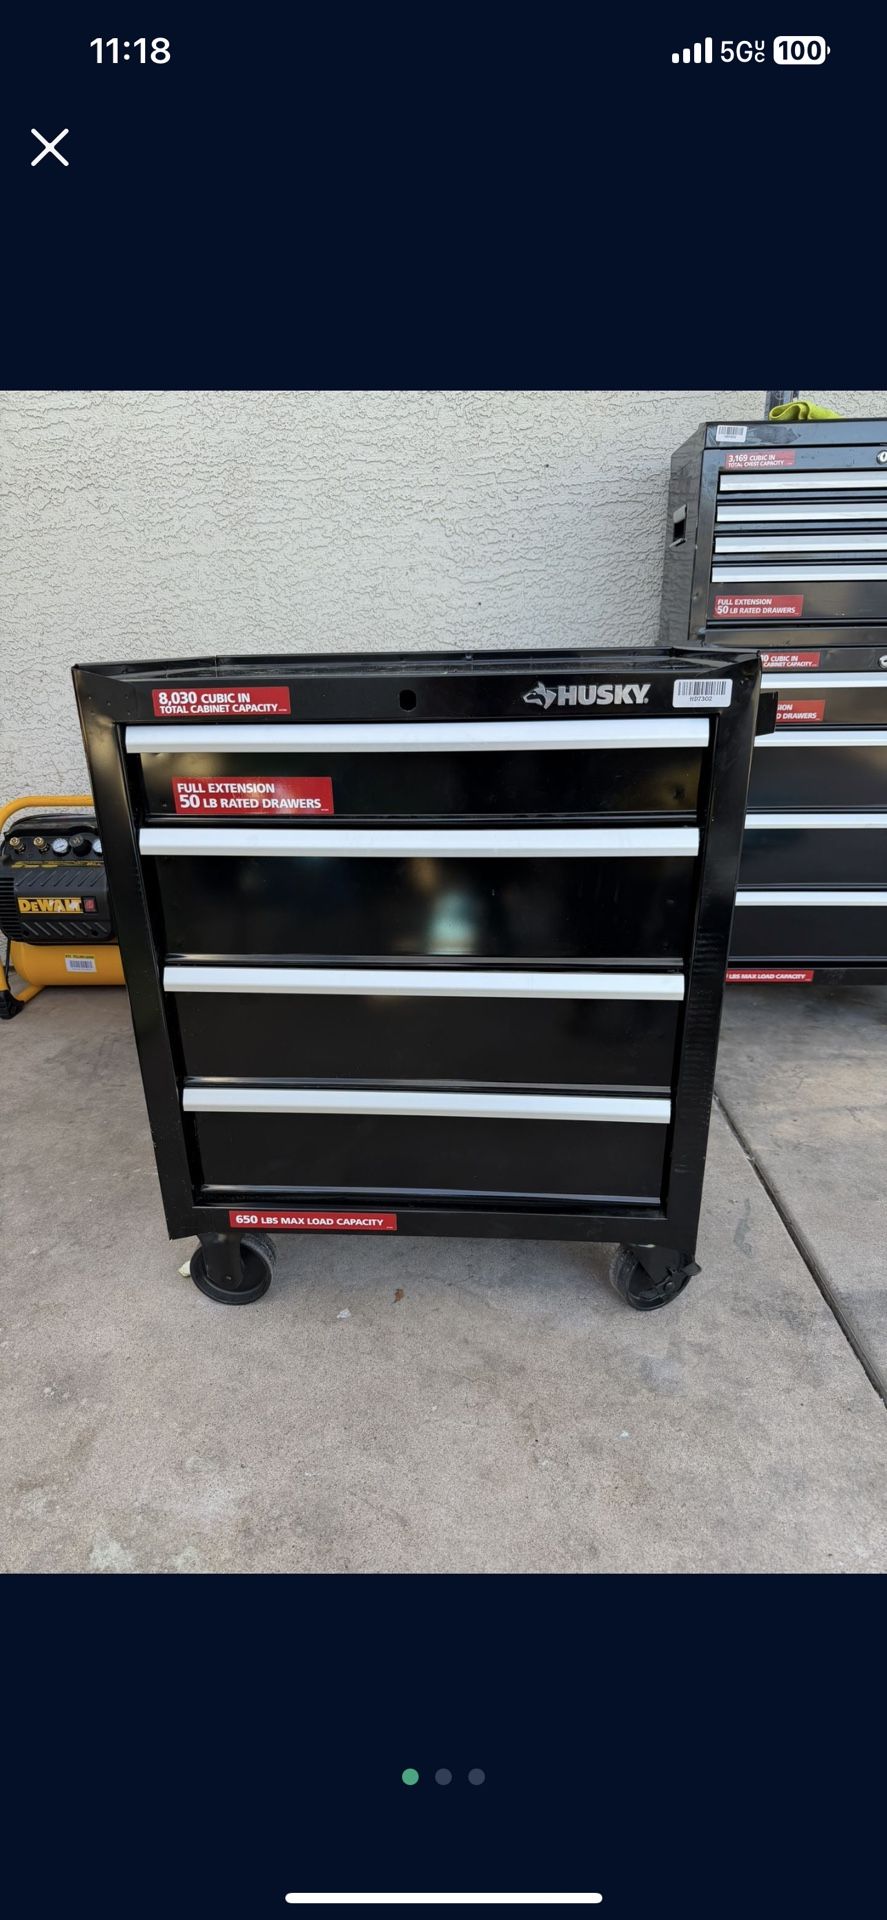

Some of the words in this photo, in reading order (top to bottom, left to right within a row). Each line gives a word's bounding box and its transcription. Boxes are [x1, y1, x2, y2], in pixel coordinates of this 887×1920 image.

[728, 454, 748, 463] 3,169
[717, 605, 729, 614] 50
[158, 691, 197, 706] 8,030
[200, 693, 236, 704] CUBIC
[237, 693, 250, 703] IN
[557, 683, 651, 706] HUSKY
[159, 704, 189, 714] TOTAL
[190, 704, 230, 714] CABINET
[231, 703, 278, 713] CAPACITY
[177, 783, 206, 793] FULL
[208, 783, 275, 794] EXTENSION
[179, 795, 200, 809] 50
[203, 799, 218, 808] LB
[220, 799, 259, 809] RATED
[262, 798, 322, 809] DRAWERS
[235, 1215, 258, 1224] 650
[281, 1217, 305, 1225] MAX
[336, 1218, 384, 1226] CAPACITY
